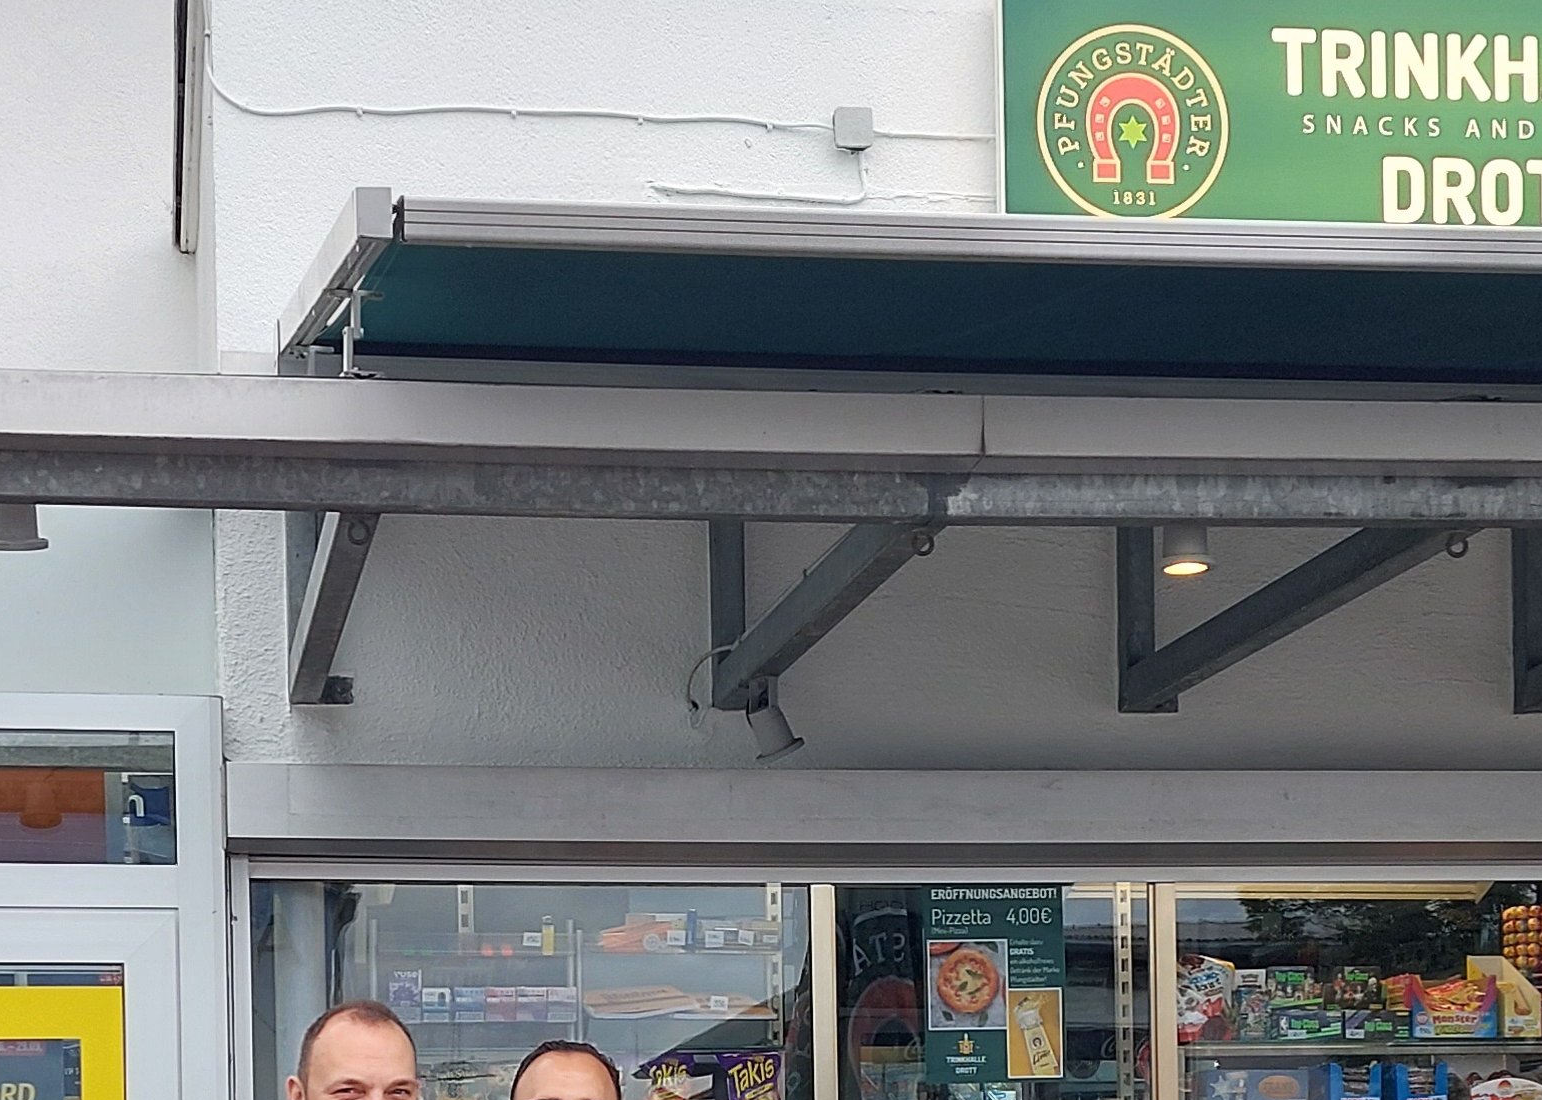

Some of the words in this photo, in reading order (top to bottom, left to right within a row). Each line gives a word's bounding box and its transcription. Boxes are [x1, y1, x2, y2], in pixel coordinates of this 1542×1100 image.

[1054, 42, 1212, 157] PFUNGSTÄDTER
[1302, 114, 1441, 137] SNACKS
[1465, 118, 1535, 140] AND
[1113, 190, 1156, 206] 1831
[931, 887, 1057, 900] ERÖFFNUNGSANGEBOT!
[931, 908, 992, 925] Pizzetta
[1006, 907, 1052, 926] 4,00€
[728, 1058, 776, 1098] Takis
